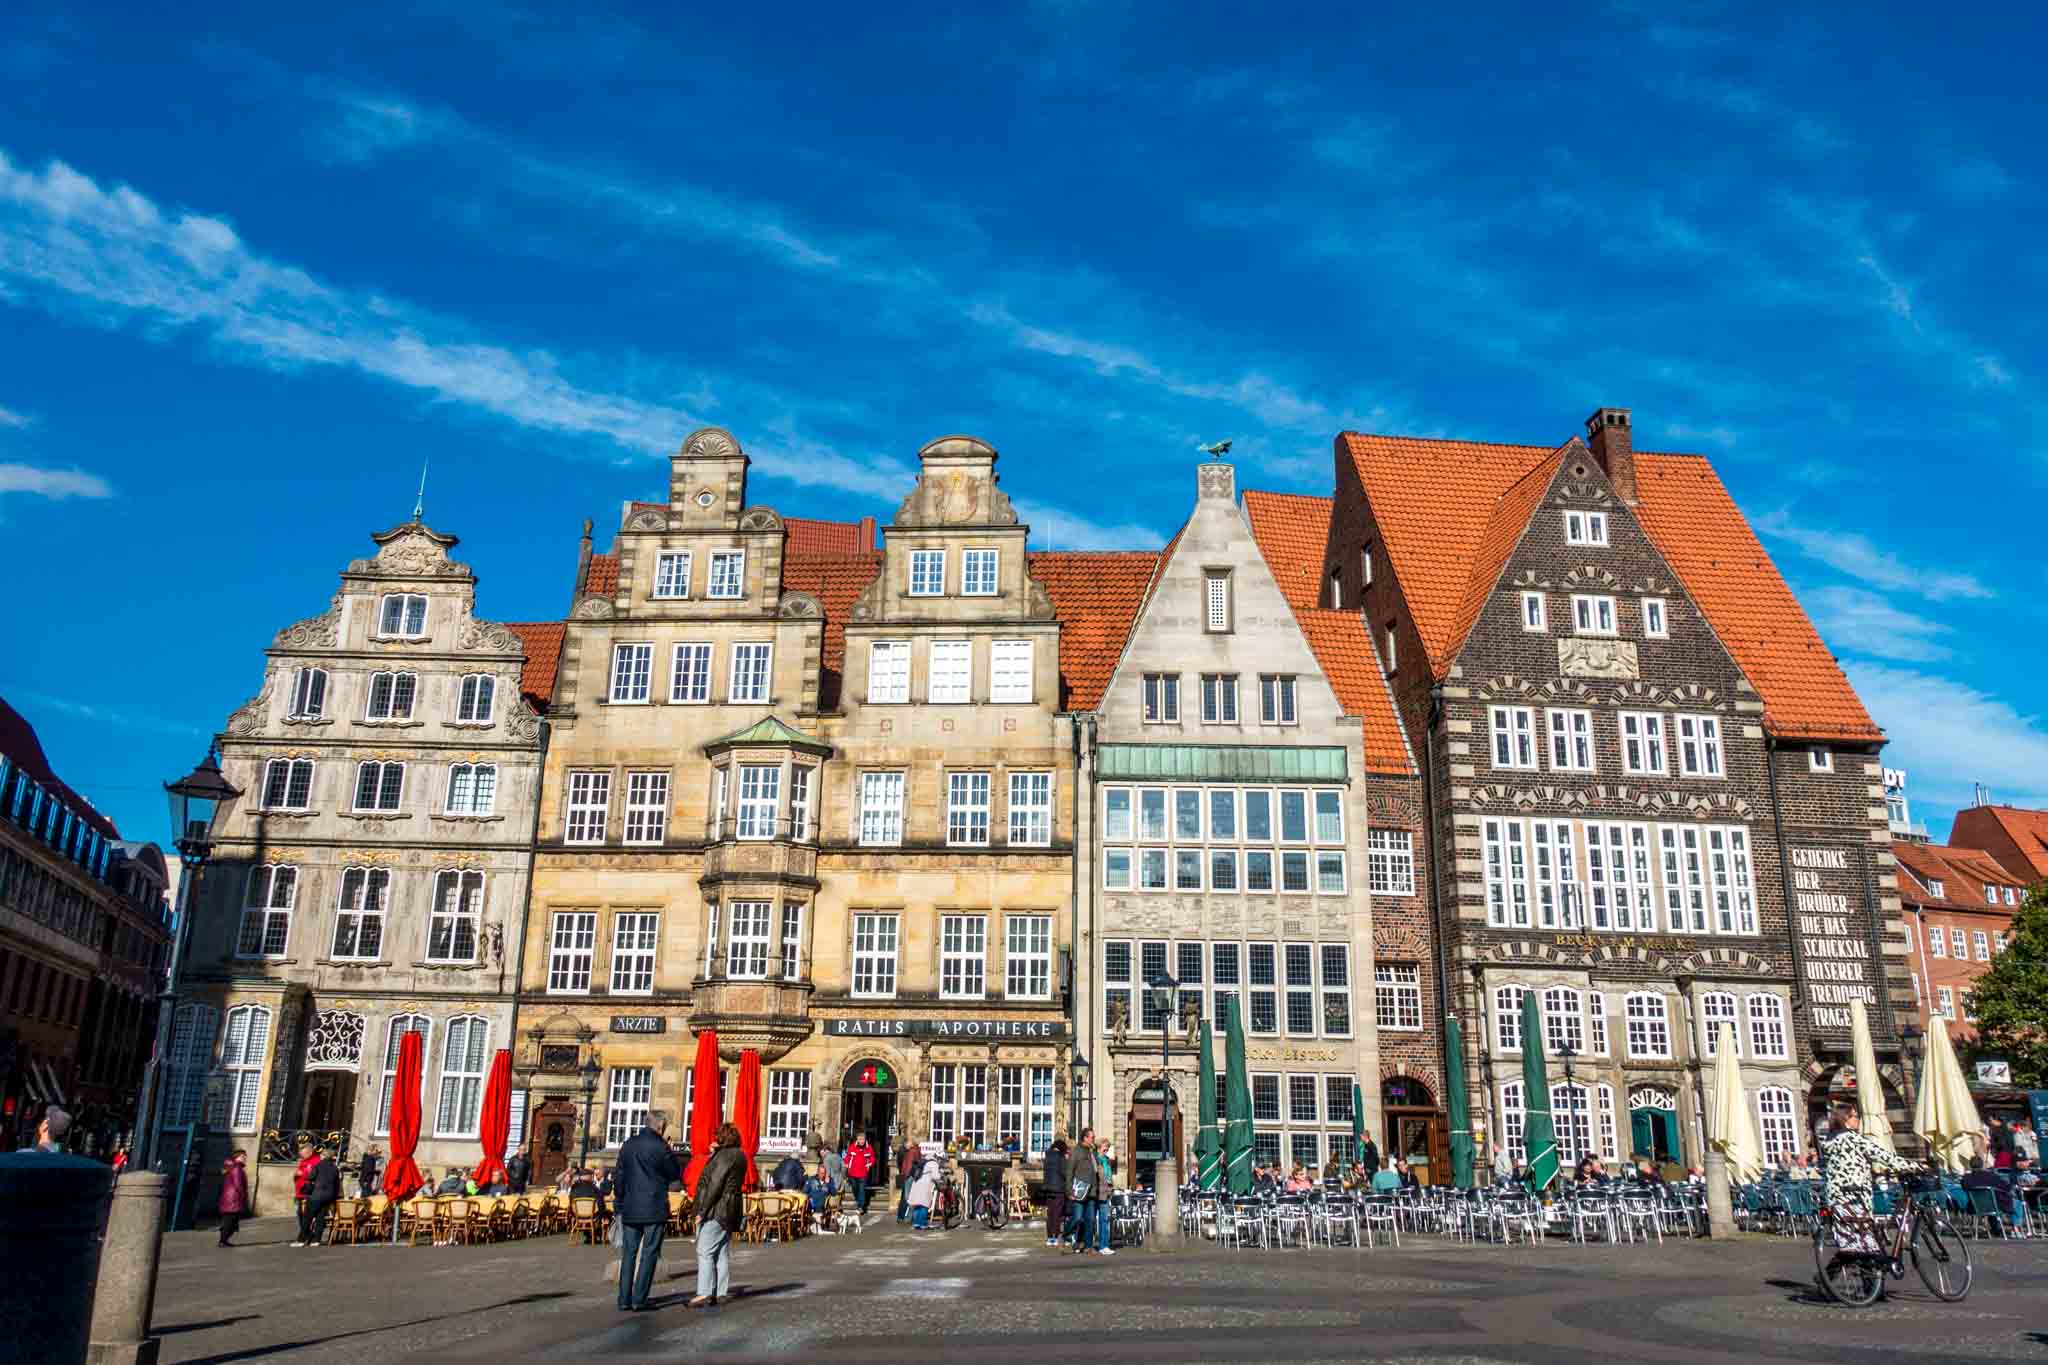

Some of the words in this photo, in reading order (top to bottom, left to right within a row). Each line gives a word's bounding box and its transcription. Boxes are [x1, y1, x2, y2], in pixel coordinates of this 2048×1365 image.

[1881, 768, 1905, 787] DT
[1792, 848, 1848, 869] GEDENKE
[1795, 872, 1820, 889] DER
[1801, 916, 1821, 934] DIE
[1823, 917, 1848, 935] DAS
[1803, 939, 1869, 958] SCHICKSAL
[1806, 961, 1864, 981] UNSERER
[1812, 1008, 1853, 1027] TRAGE
[838, 1020, 904, 1034] RATHS
[938, 1022, 1051, 1036] APOTHEKE
